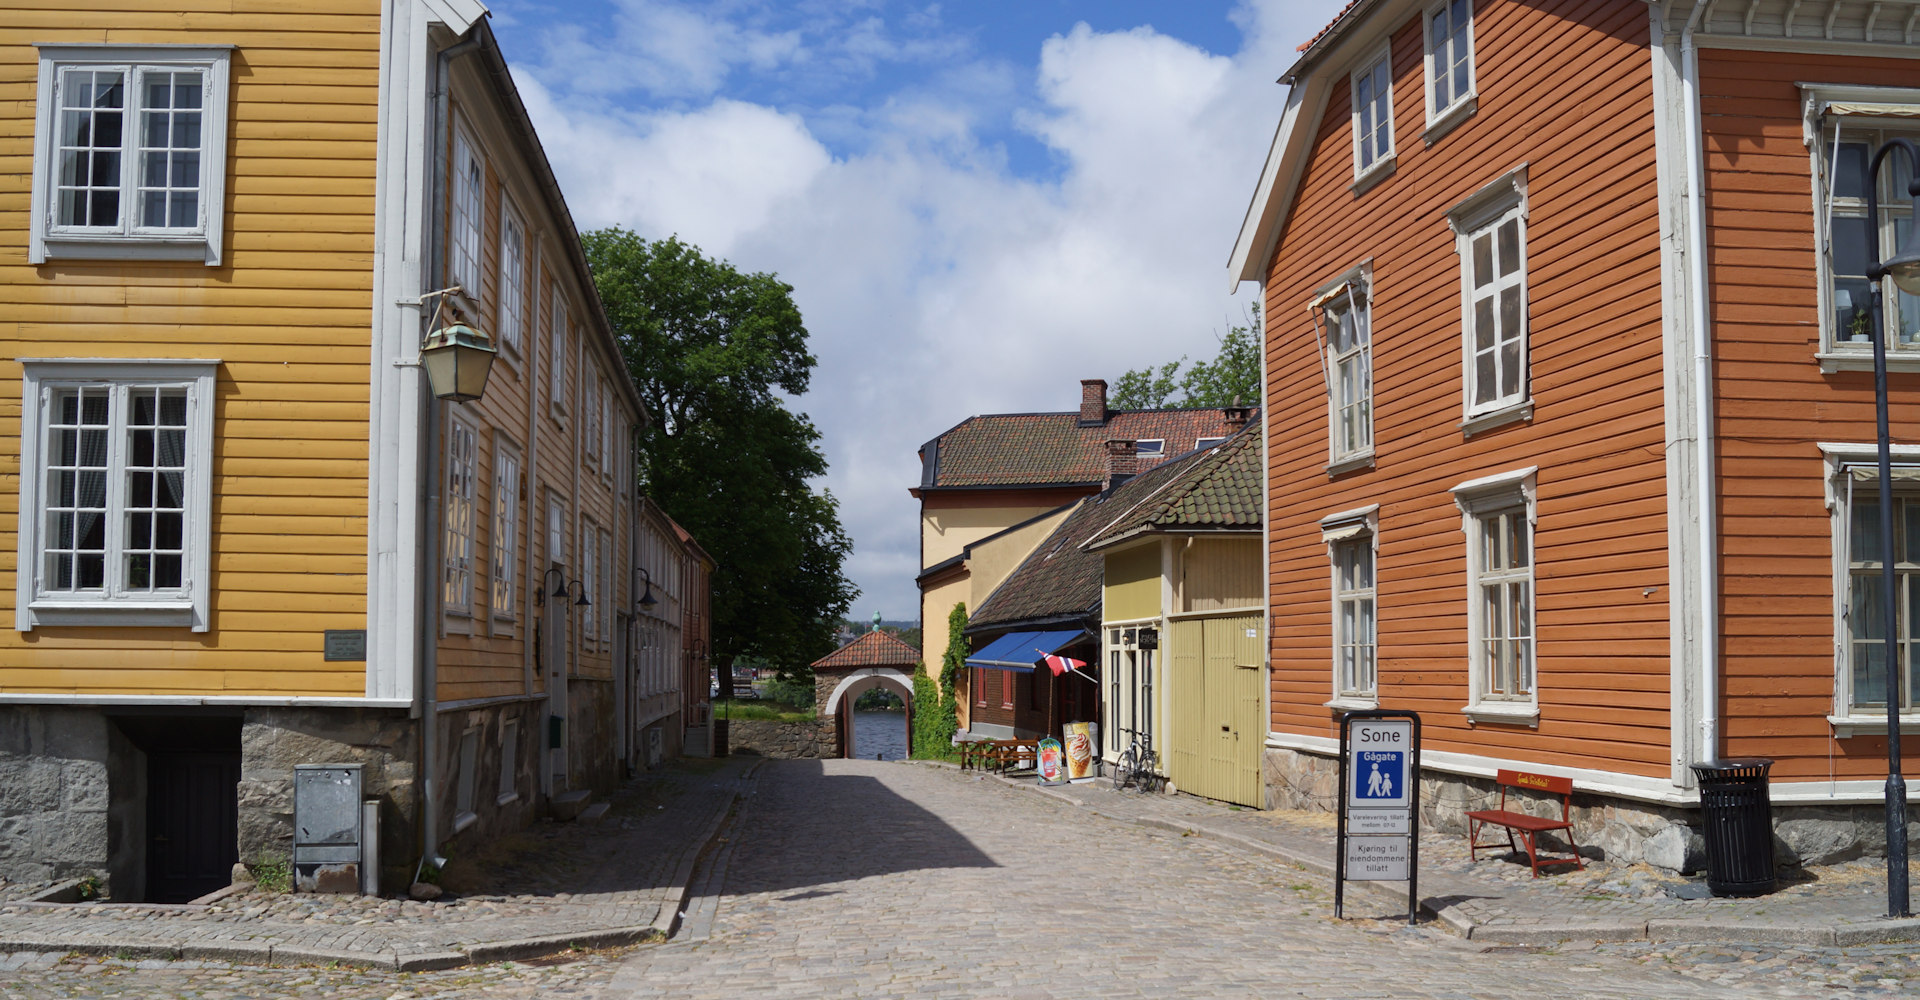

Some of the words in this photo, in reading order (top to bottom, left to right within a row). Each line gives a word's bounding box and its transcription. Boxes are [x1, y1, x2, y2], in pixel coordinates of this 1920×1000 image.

[1361, 728, 1400, 742] Sone
[1363, 752, 1397, 763] Gågate
[1358, 845, 1386, 854] Kjøring
